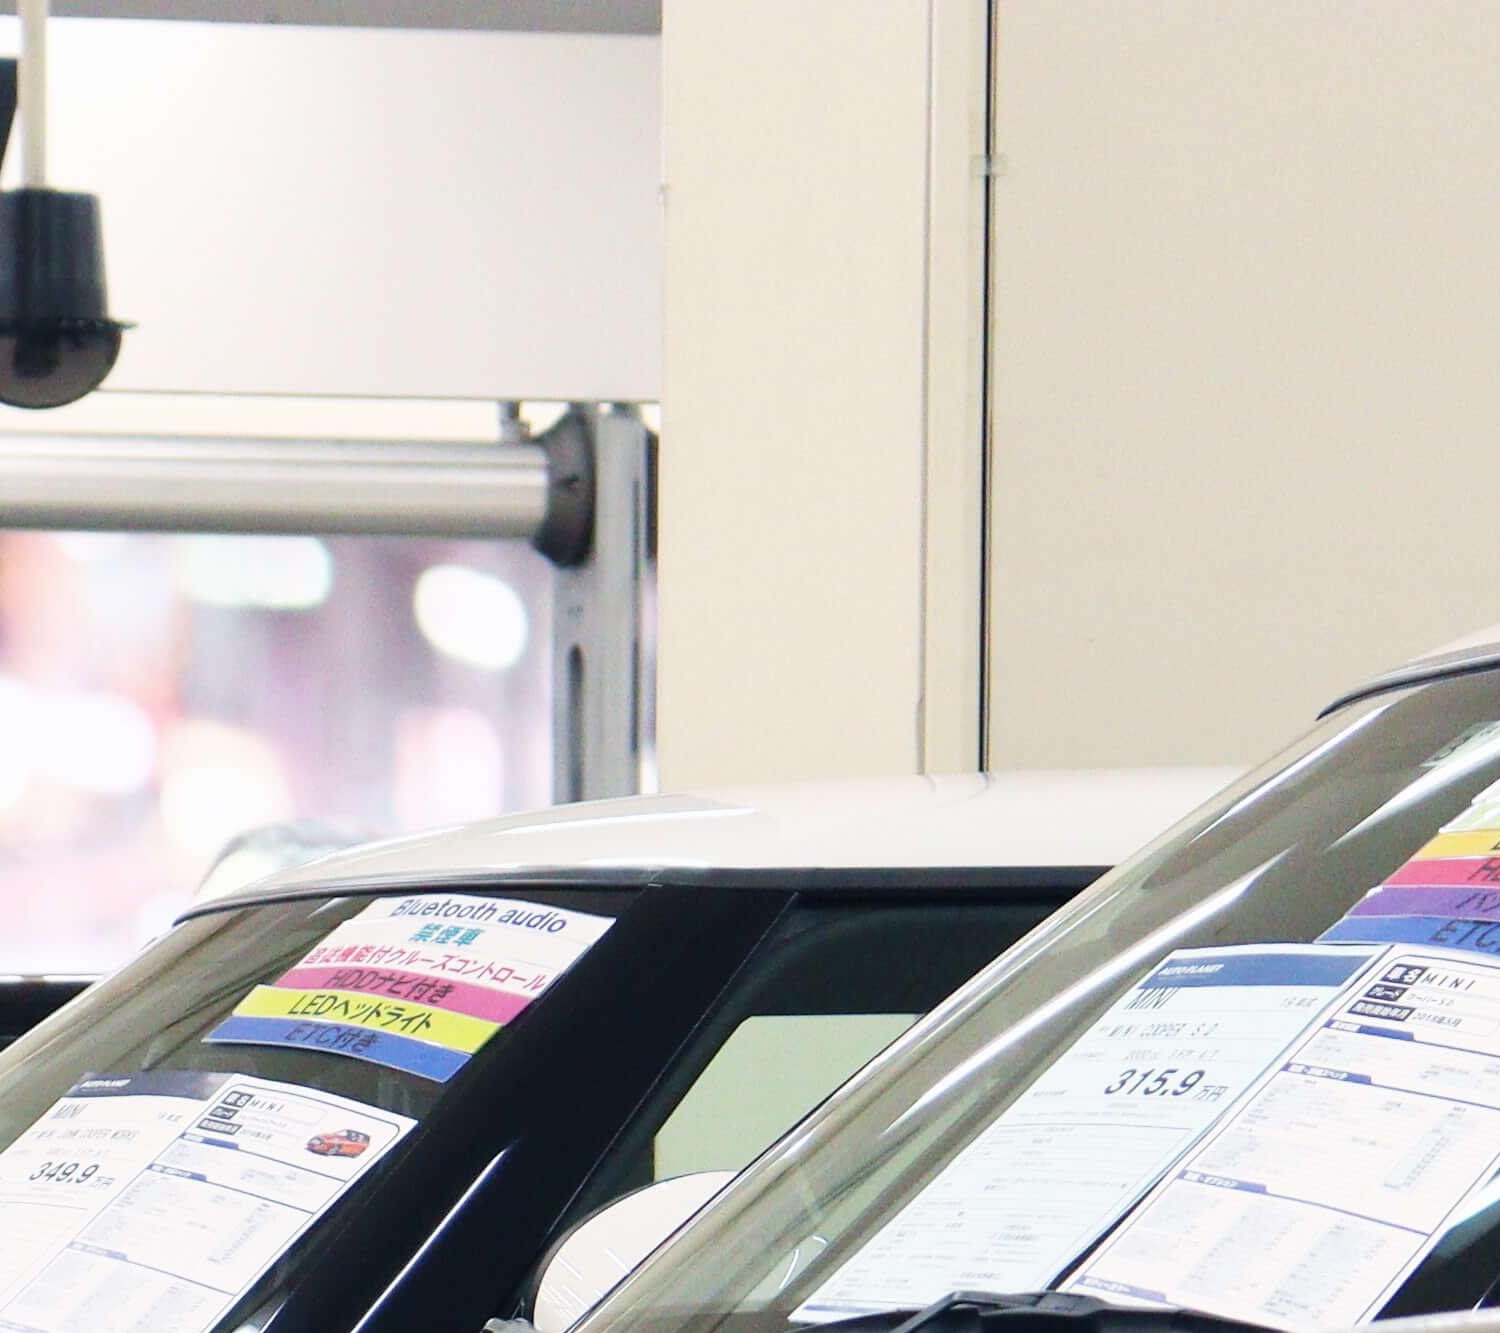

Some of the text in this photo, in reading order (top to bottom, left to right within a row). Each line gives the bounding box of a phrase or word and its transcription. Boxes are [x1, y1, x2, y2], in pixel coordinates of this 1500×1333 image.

[389, 898, 568, 934] Bluetooth audio
[408, 923, 484, 947] 禁煙車
[1421, 972, 1476, 992] MINI
[287, 993, 432, 1032] LEDヘッドライト
[1104, 1068, 1206, 1096] 315.9
[30, 1162, 100, 1183] 349.9
